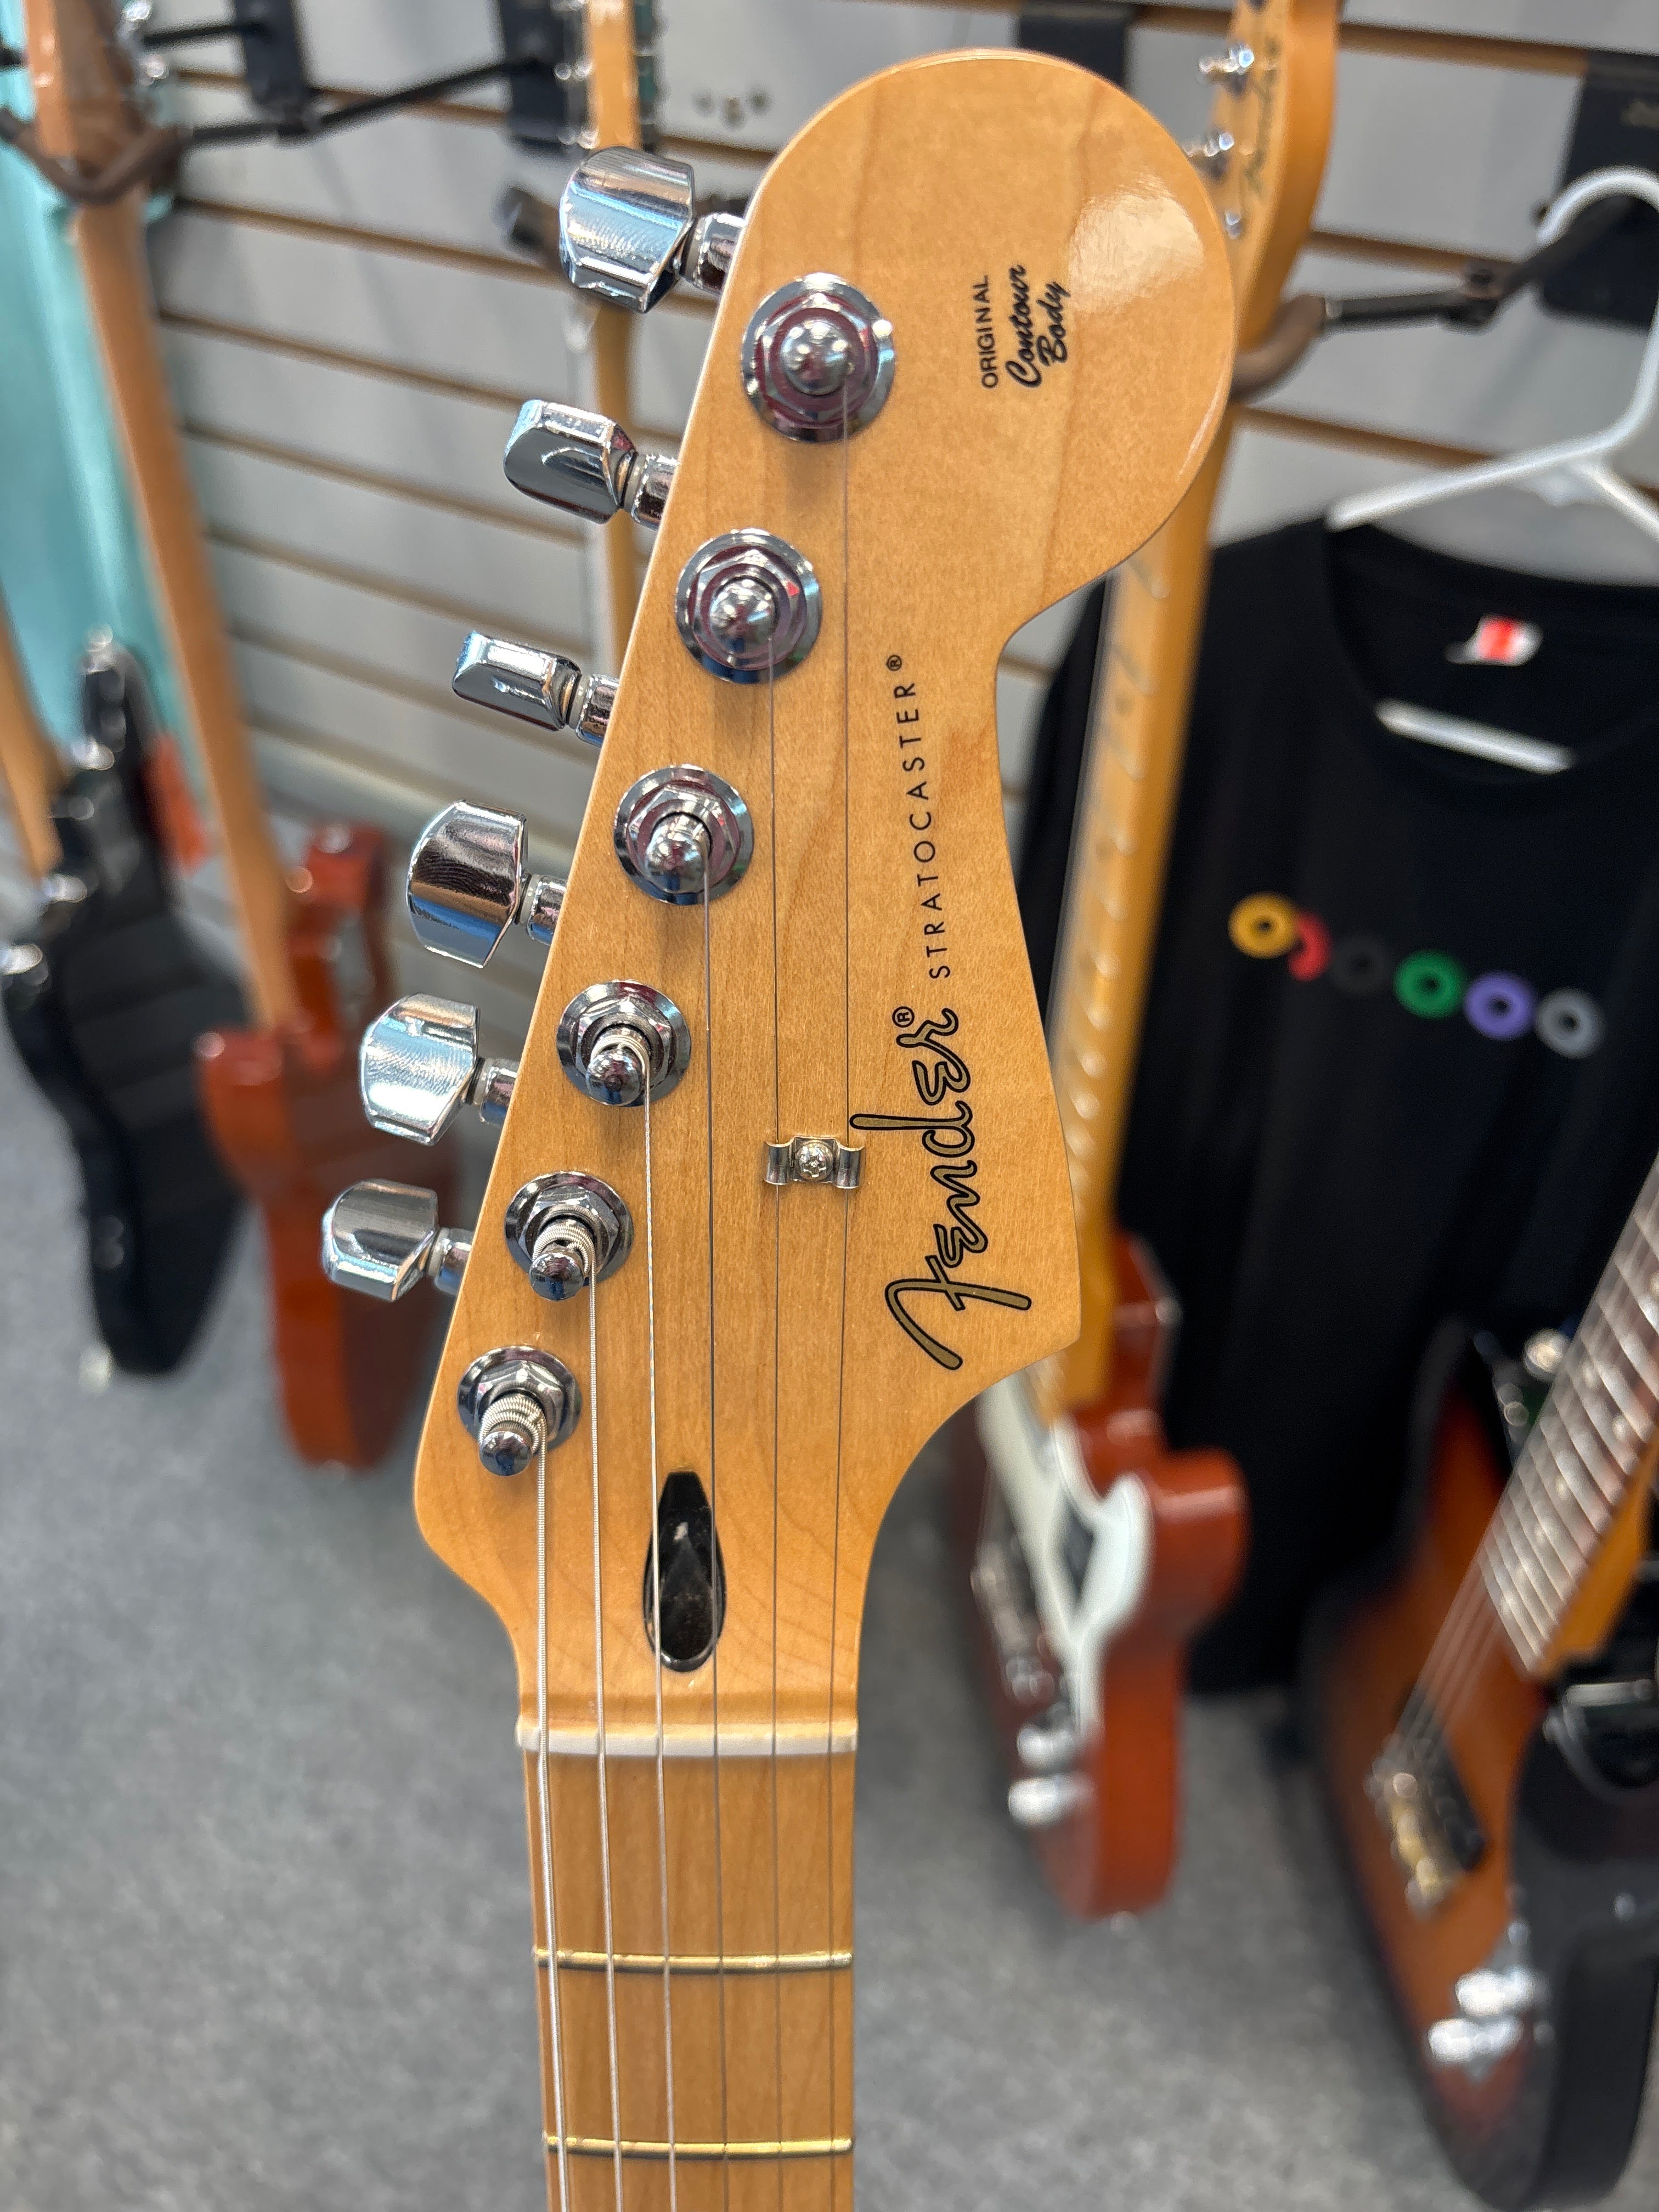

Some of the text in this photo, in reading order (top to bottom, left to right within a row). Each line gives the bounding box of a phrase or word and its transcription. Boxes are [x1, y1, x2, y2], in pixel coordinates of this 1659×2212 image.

[972, 275, 999, 389] ORIGINAL
[1005, 264, 1042, 388] Contour
[1036, 281, 1070, 366] Body
